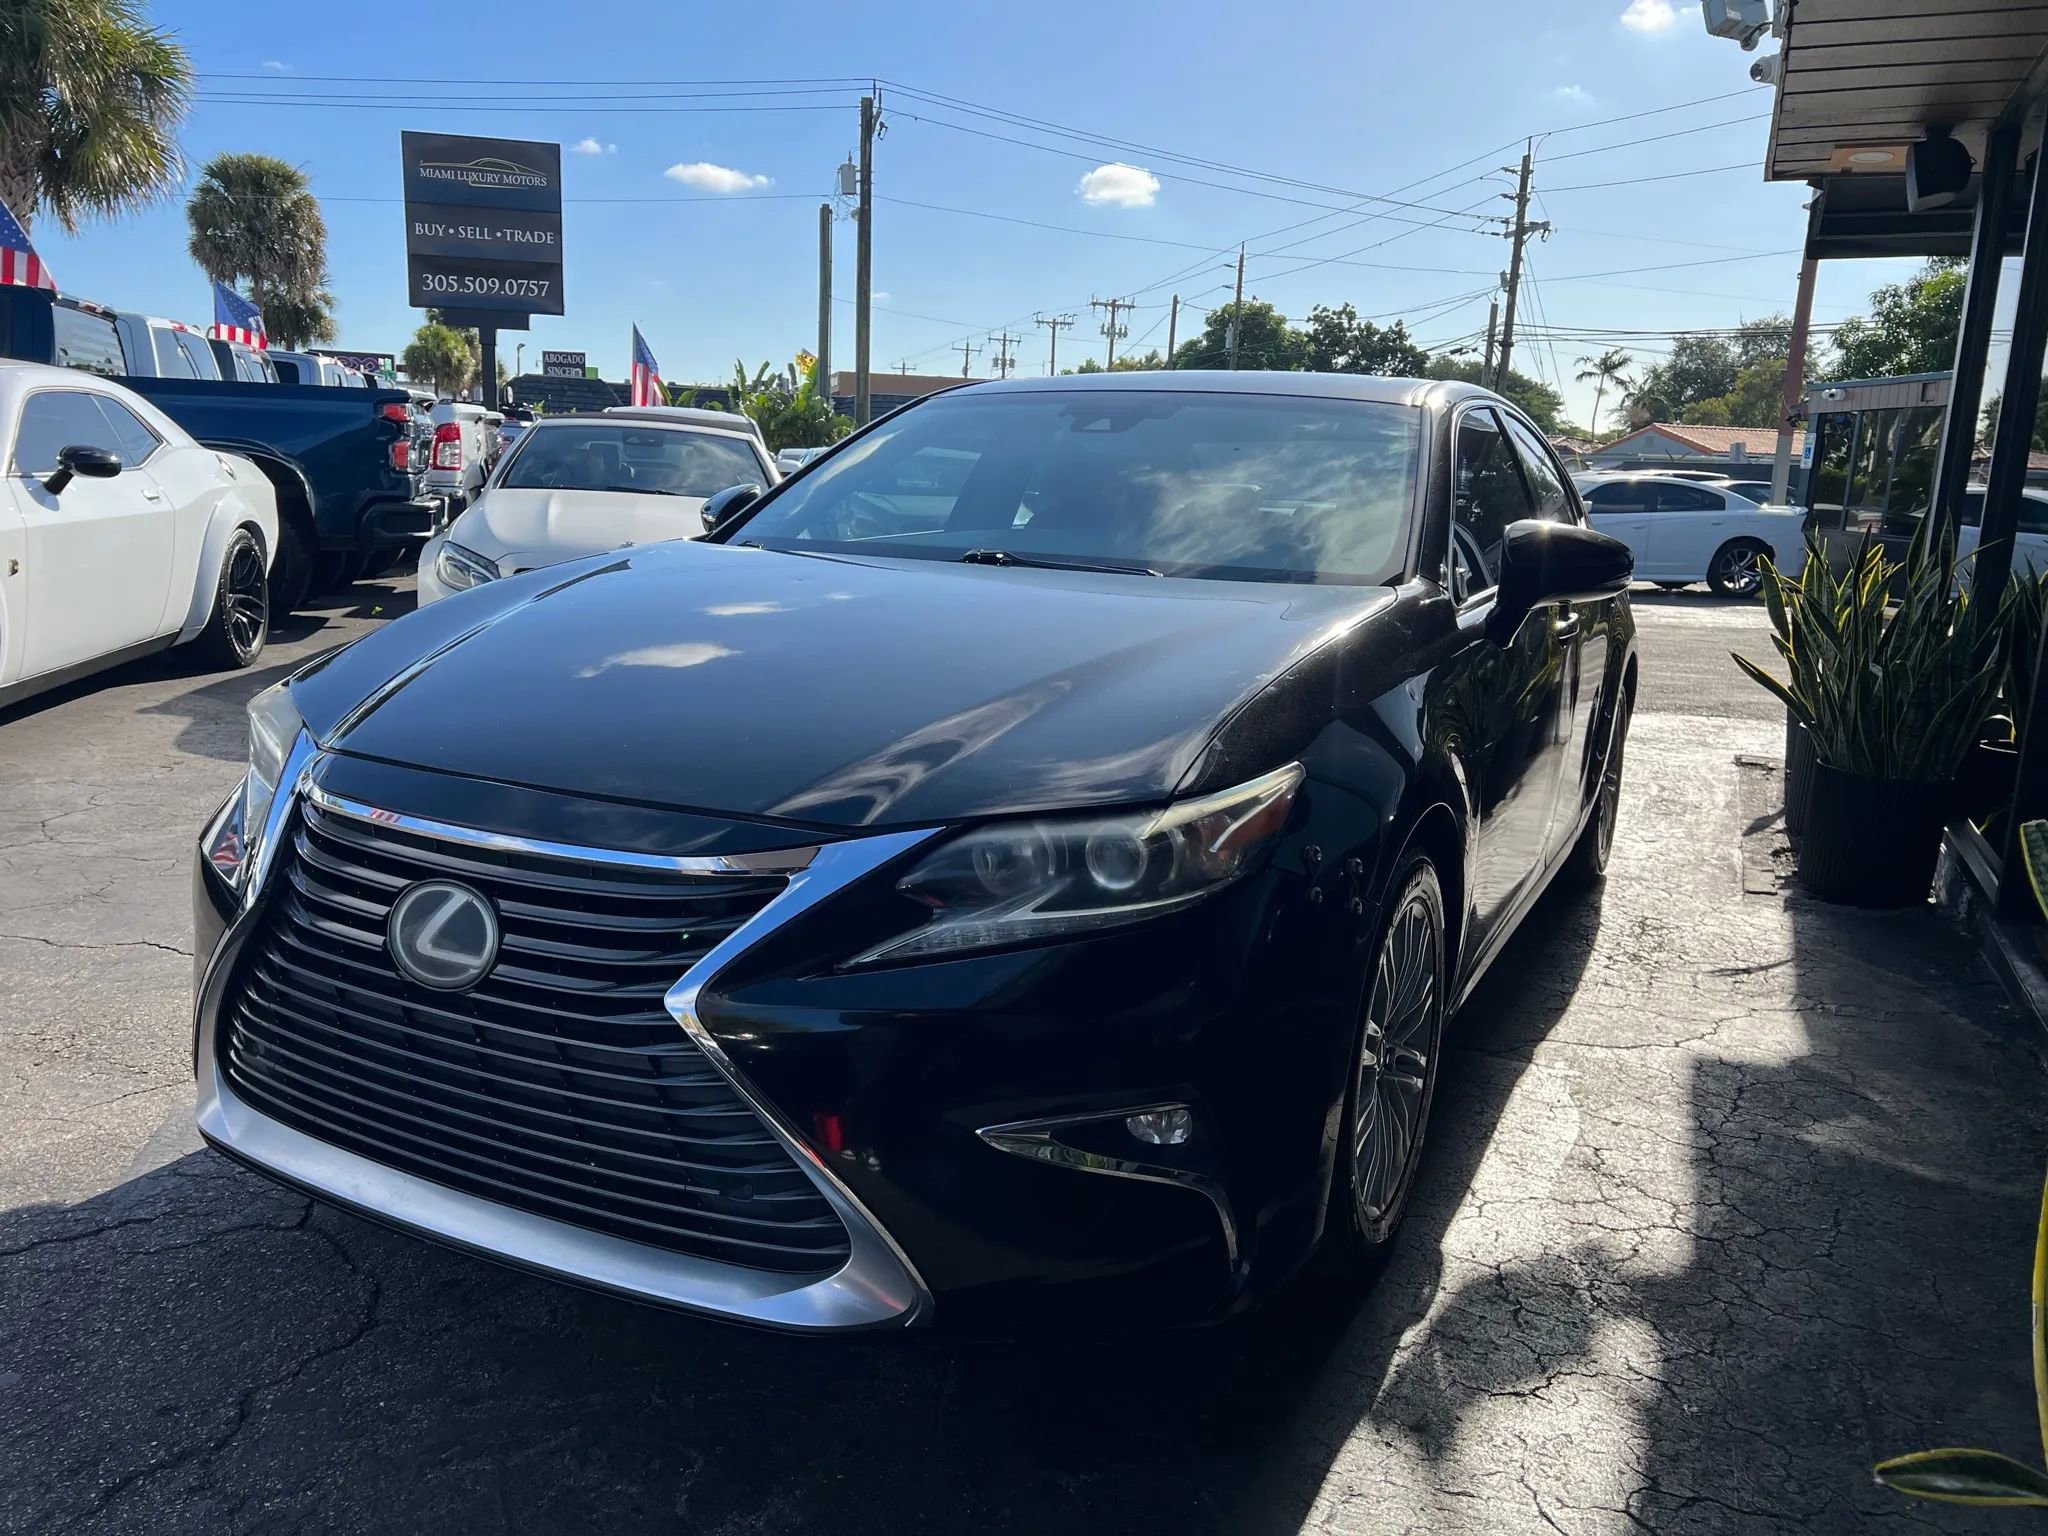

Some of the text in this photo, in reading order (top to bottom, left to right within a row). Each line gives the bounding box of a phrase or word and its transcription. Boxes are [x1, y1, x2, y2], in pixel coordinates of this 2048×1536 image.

[419, 167, 547, 187] MIAMI LUXURY MOTORS
[415, 222, 555, 244] BUY SELL TRADE
[422, 273, 550, 297] 305.509.0757
[544, 353, 585, 365] ABOGADO
